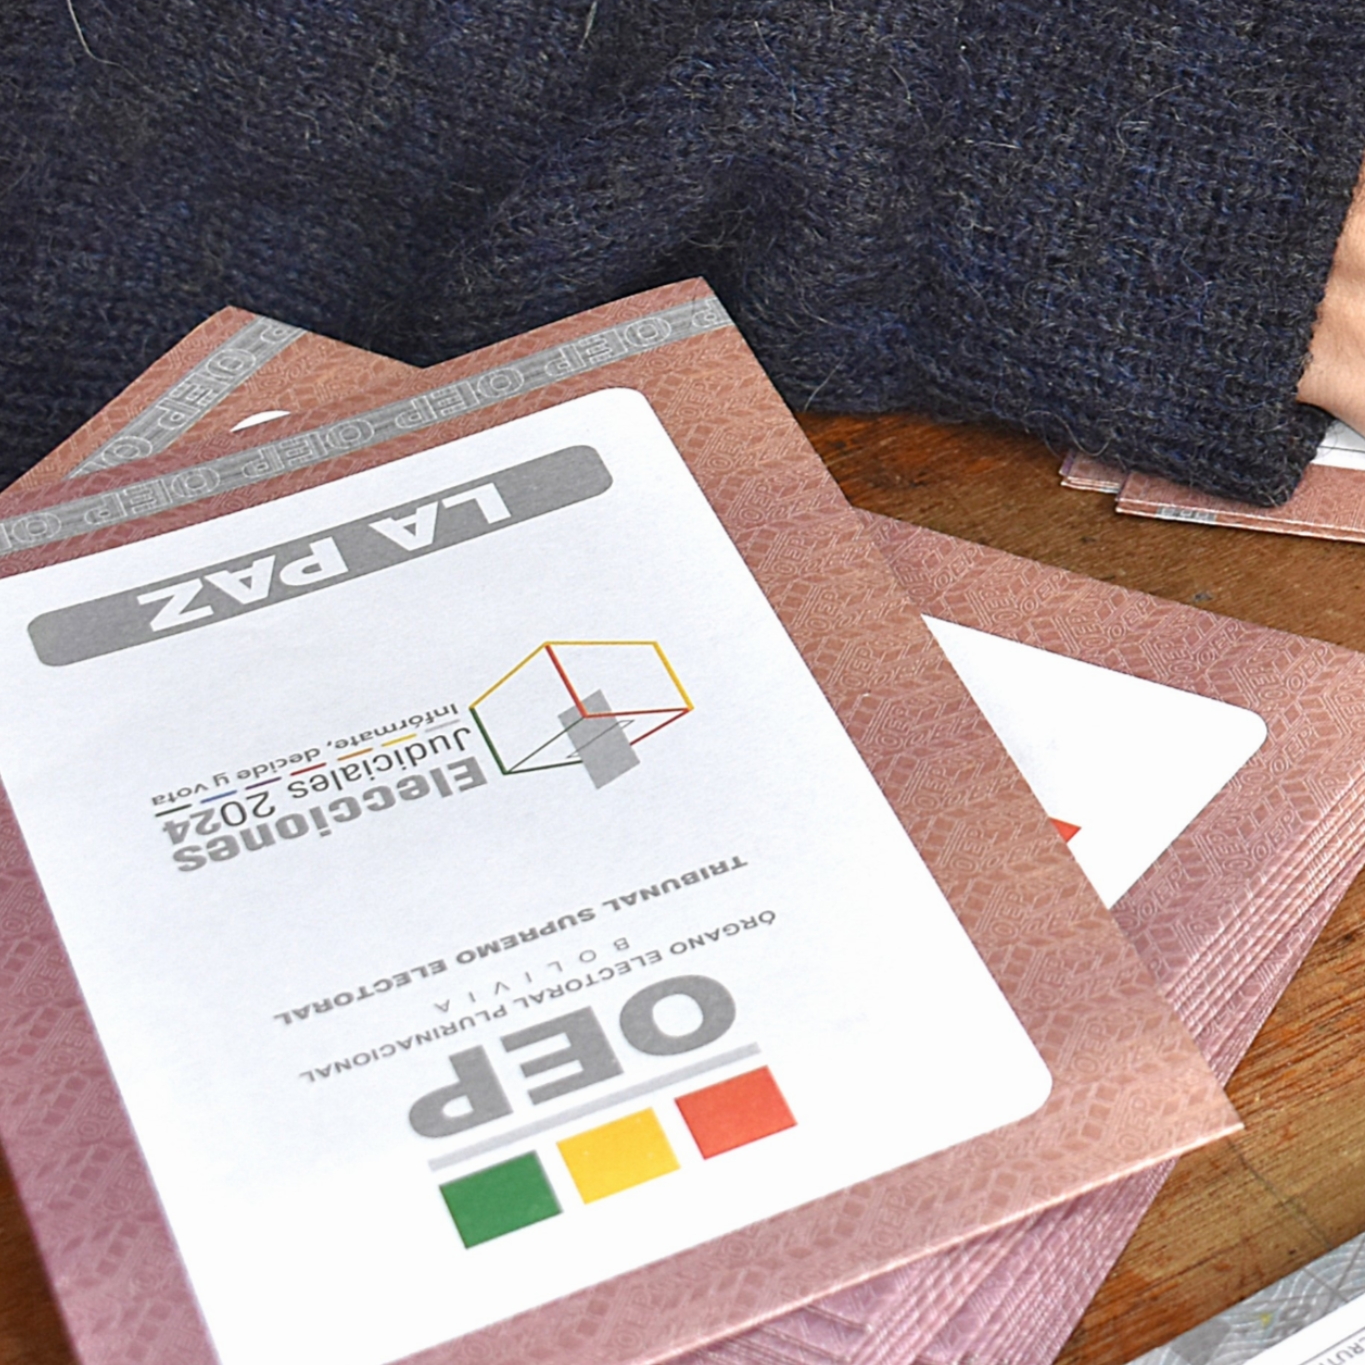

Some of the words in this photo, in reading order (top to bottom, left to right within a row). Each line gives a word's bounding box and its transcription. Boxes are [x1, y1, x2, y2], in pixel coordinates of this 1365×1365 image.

[368, 482, 511, 551] LA
[136, 537, 348, 632] PAZ
[212, 772, 230, 787] y
[236, 748, 321, 780] decide
[287, 727, 471, 799] Judiciales
[151, 783, 209, 806] vota
[162, 791, 276, 845] 2024
[172, 750, 488, 872] Elecciones
[602, 856, 748, 912] TRIBUNAL
[455, 908, 596, 965] SUPREMO
[669, 910, 776, 955] ÓRGANO
[273, 959, 448, 1025] ELECTORAL
[513, 950, 663, 1008] ELECTORAL
[299, 1004, 508, 1083] PLURINACIONAL
[408, 974, 736, 1139] OEP
